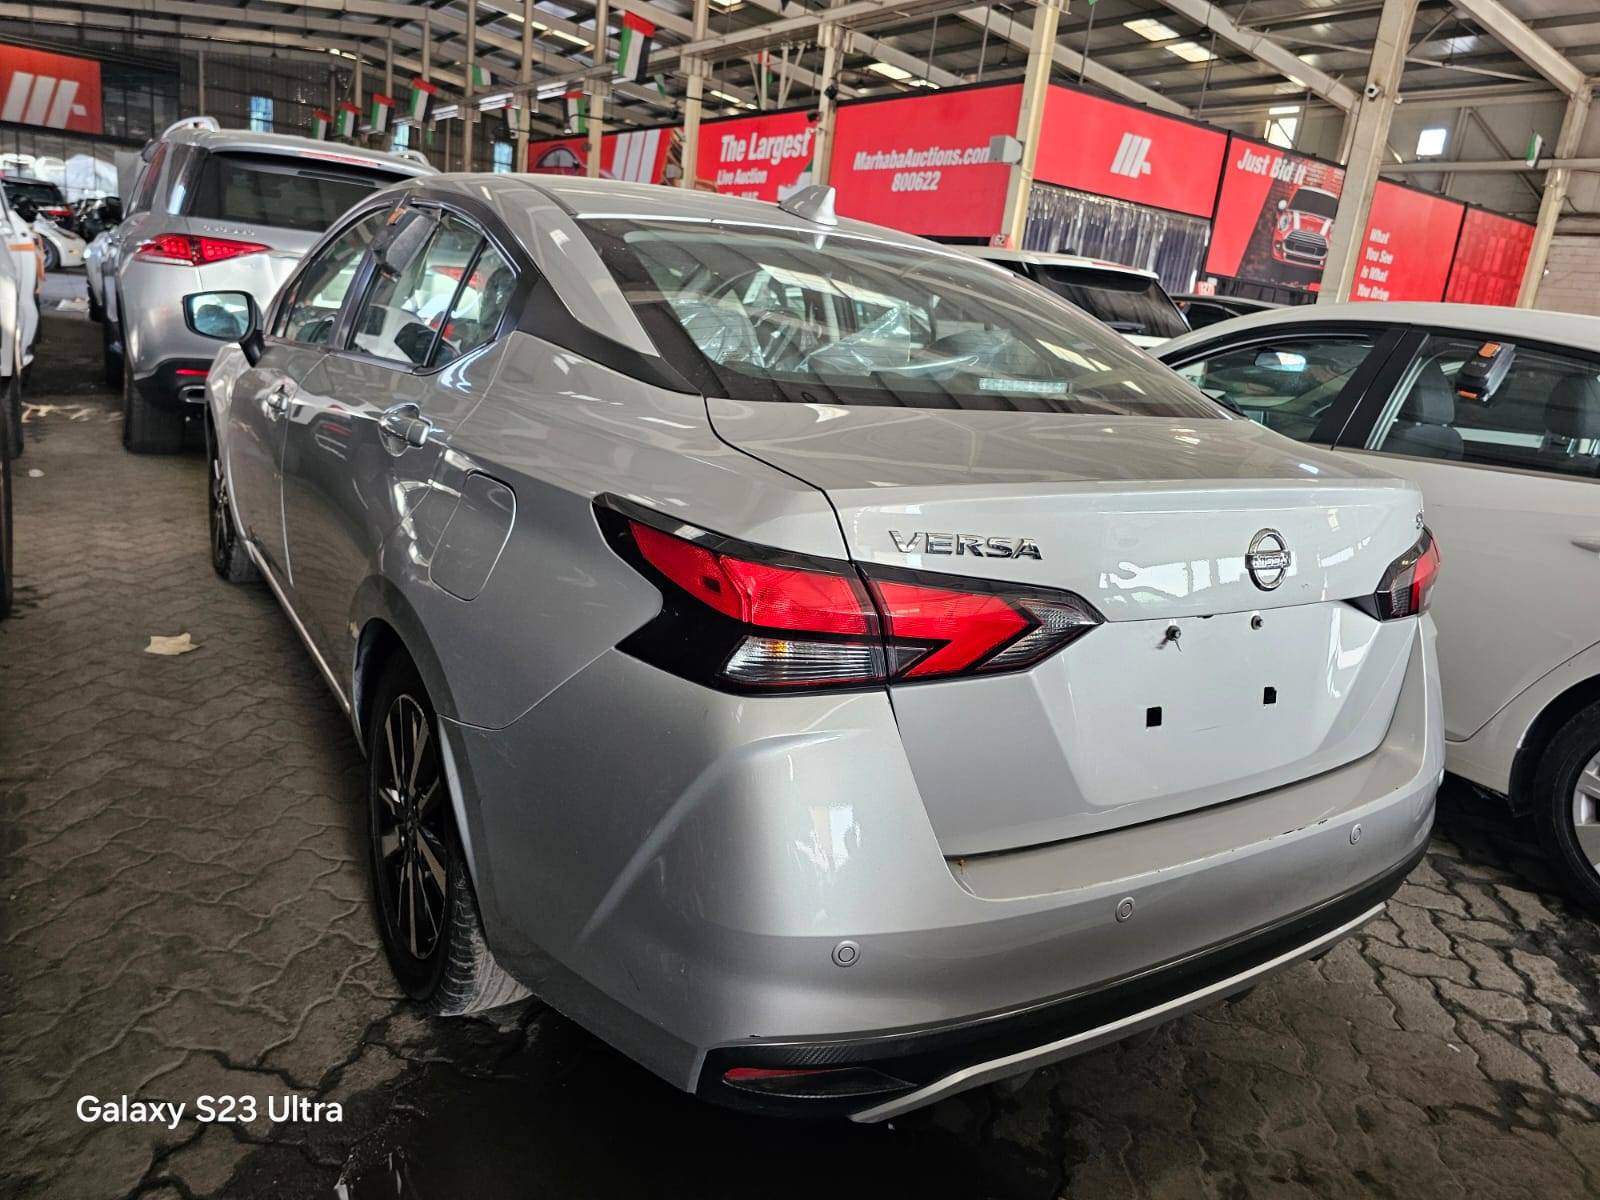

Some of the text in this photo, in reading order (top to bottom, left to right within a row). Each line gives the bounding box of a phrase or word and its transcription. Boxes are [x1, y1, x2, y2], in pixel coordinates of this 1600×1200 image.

[720, 127, 812, 166] The Largest
[1237, 148, 1271, 176] Just
[1269, 157, 1295, 182] Bid
[717, 168, 768, 185] Live Auction
[891, 170, 942, 192] 800622
[1369, 228, 1390, 245] What
[1366, 246, 1394, 265] You See
[1360, 265, 1389, 282] Is What
[1357, 283, 1372, 297] You
[888, 530, 1043, 560] VERSA
